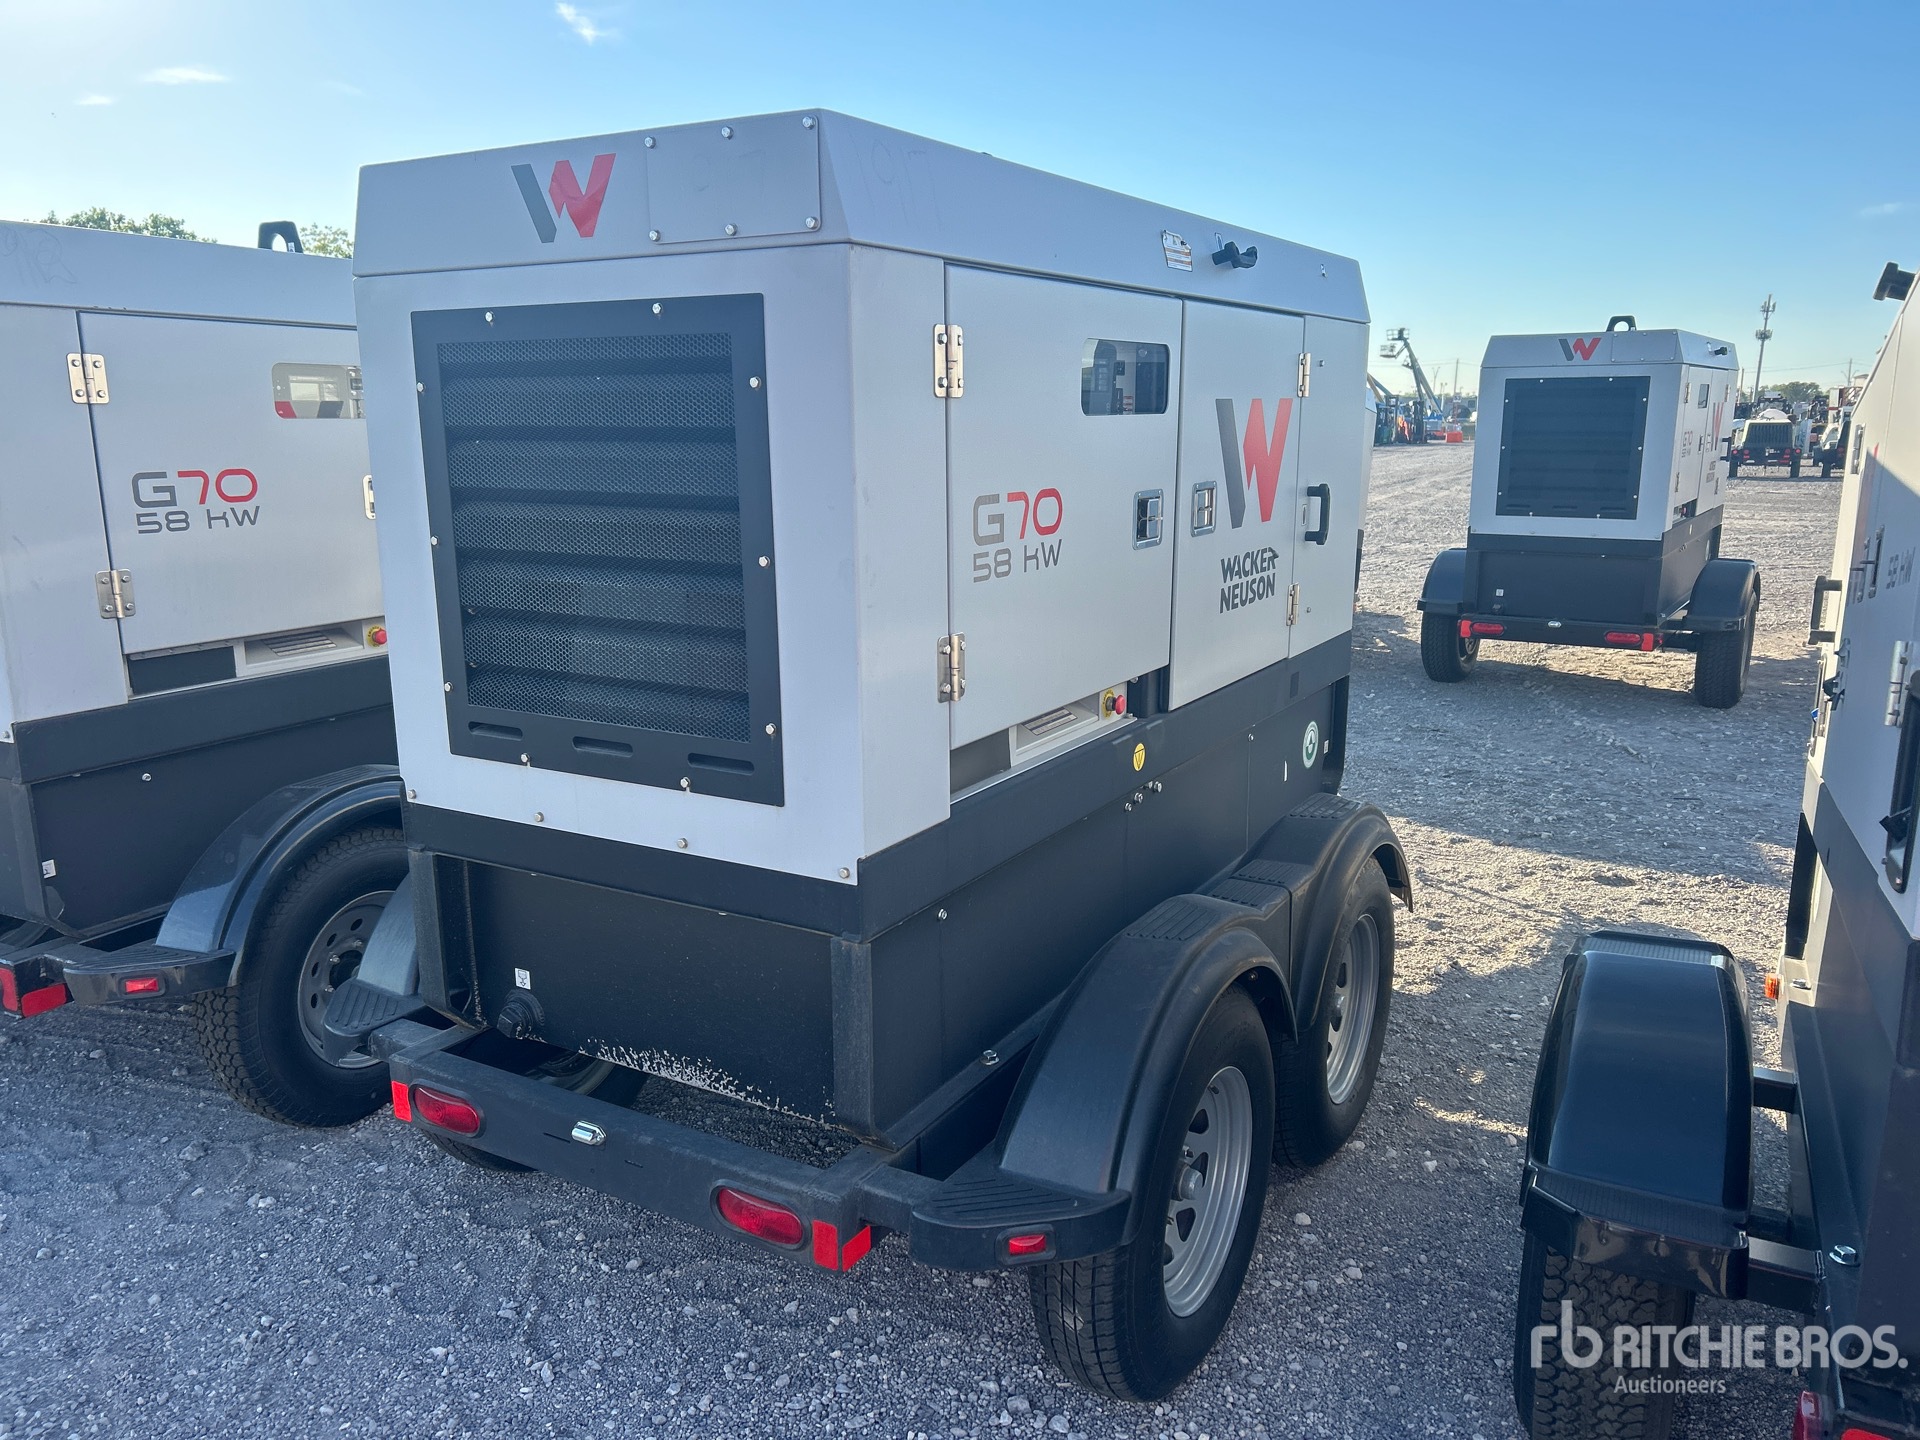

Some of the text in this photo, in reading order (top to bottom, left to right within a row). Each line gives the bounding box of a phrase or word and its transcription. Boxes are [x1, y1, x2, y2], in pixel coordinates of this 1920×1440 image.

[131, 468, 258, 509] G70
[136, 505, 260, 535] 58 kW
[973, 488, 1063, 547] G70
[973, 539, 1062, 584] 58 kW
[1220, 546, 1280, 584] WACKER
[1219, 572, 1276, 614] NEUSON
